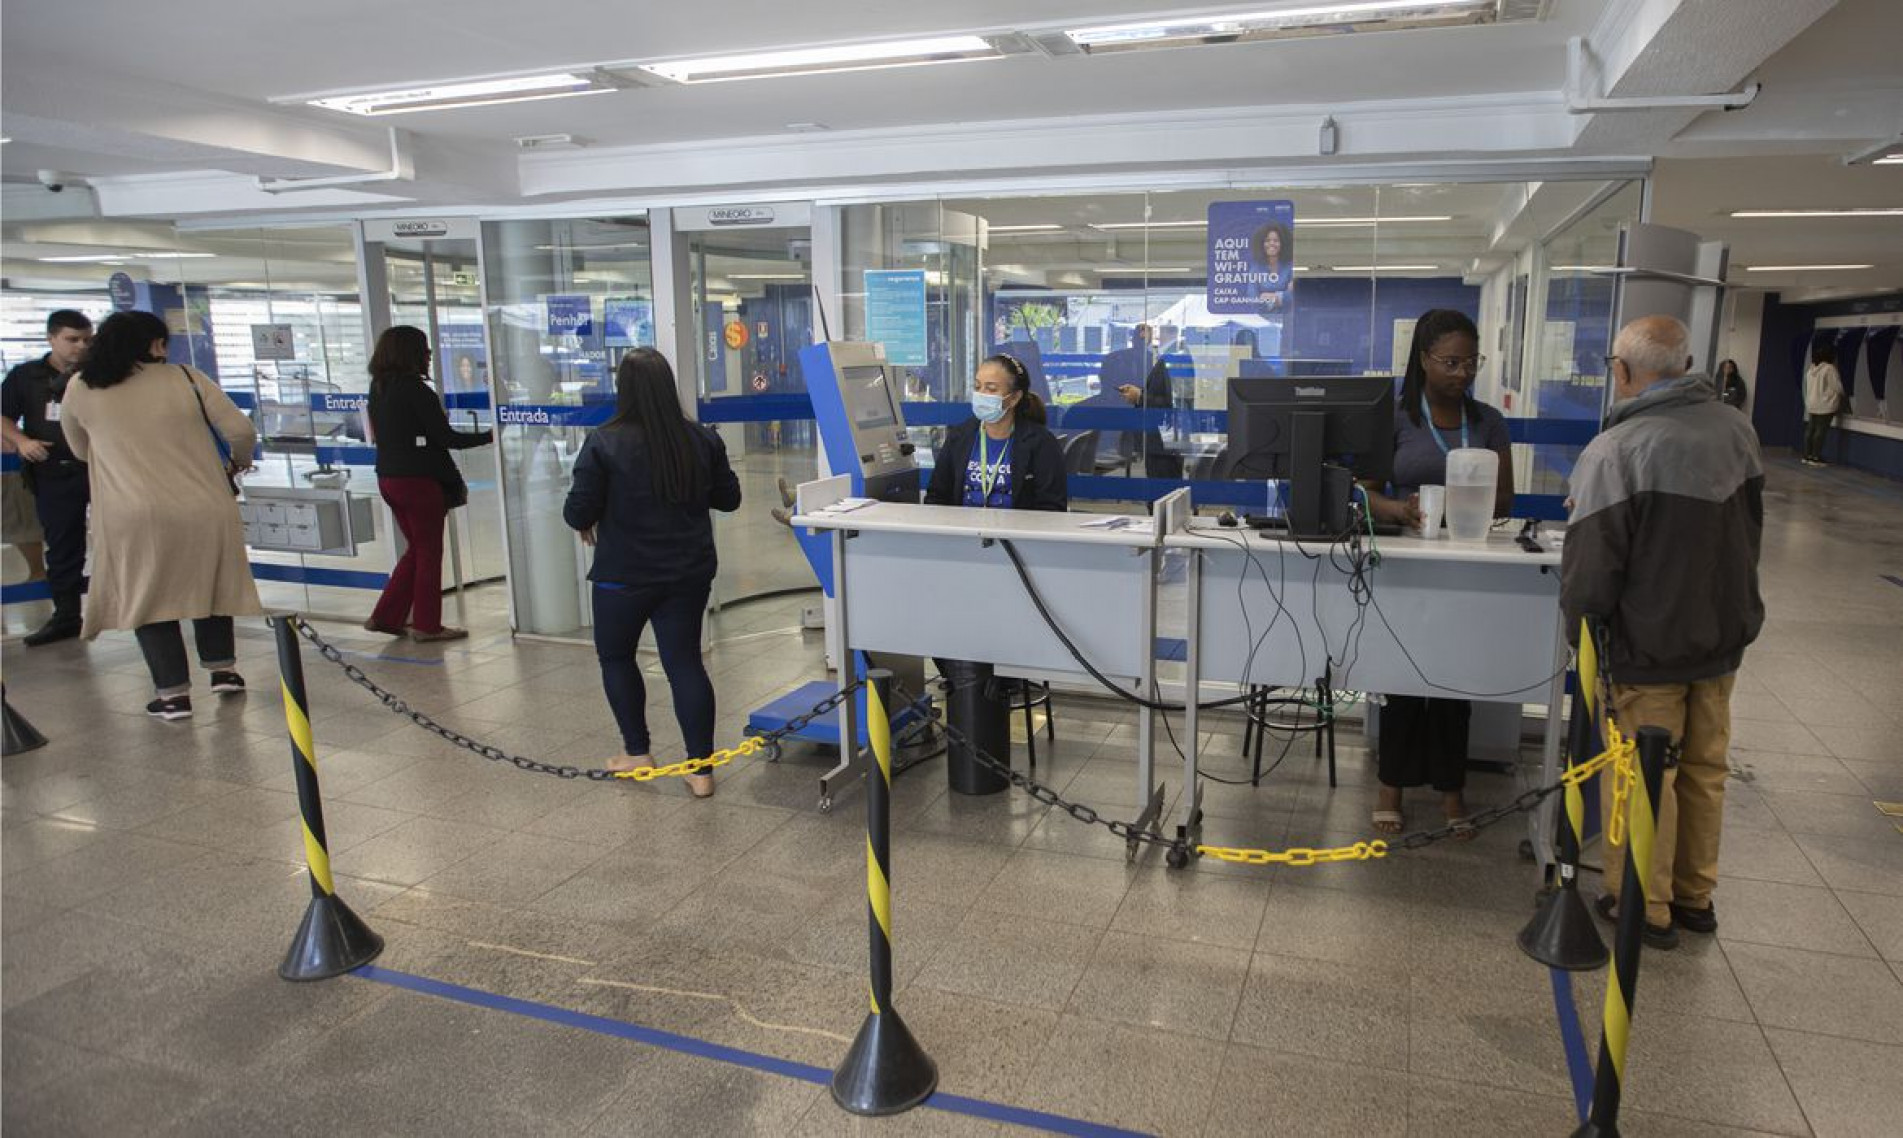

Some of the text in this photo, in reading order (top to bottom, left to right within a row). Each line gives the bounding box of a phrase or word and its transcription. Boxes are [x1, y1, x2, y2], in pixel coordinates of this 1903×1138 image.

[1215, 238, 1248, 249] AQUI
[1214, 250, 1239, 260] TEM
[1214, 262, 1246, 272] WI-FI
[1214, 273, 1279, 283] GRATUITO
[499, 406, 549, 423] Entrada
